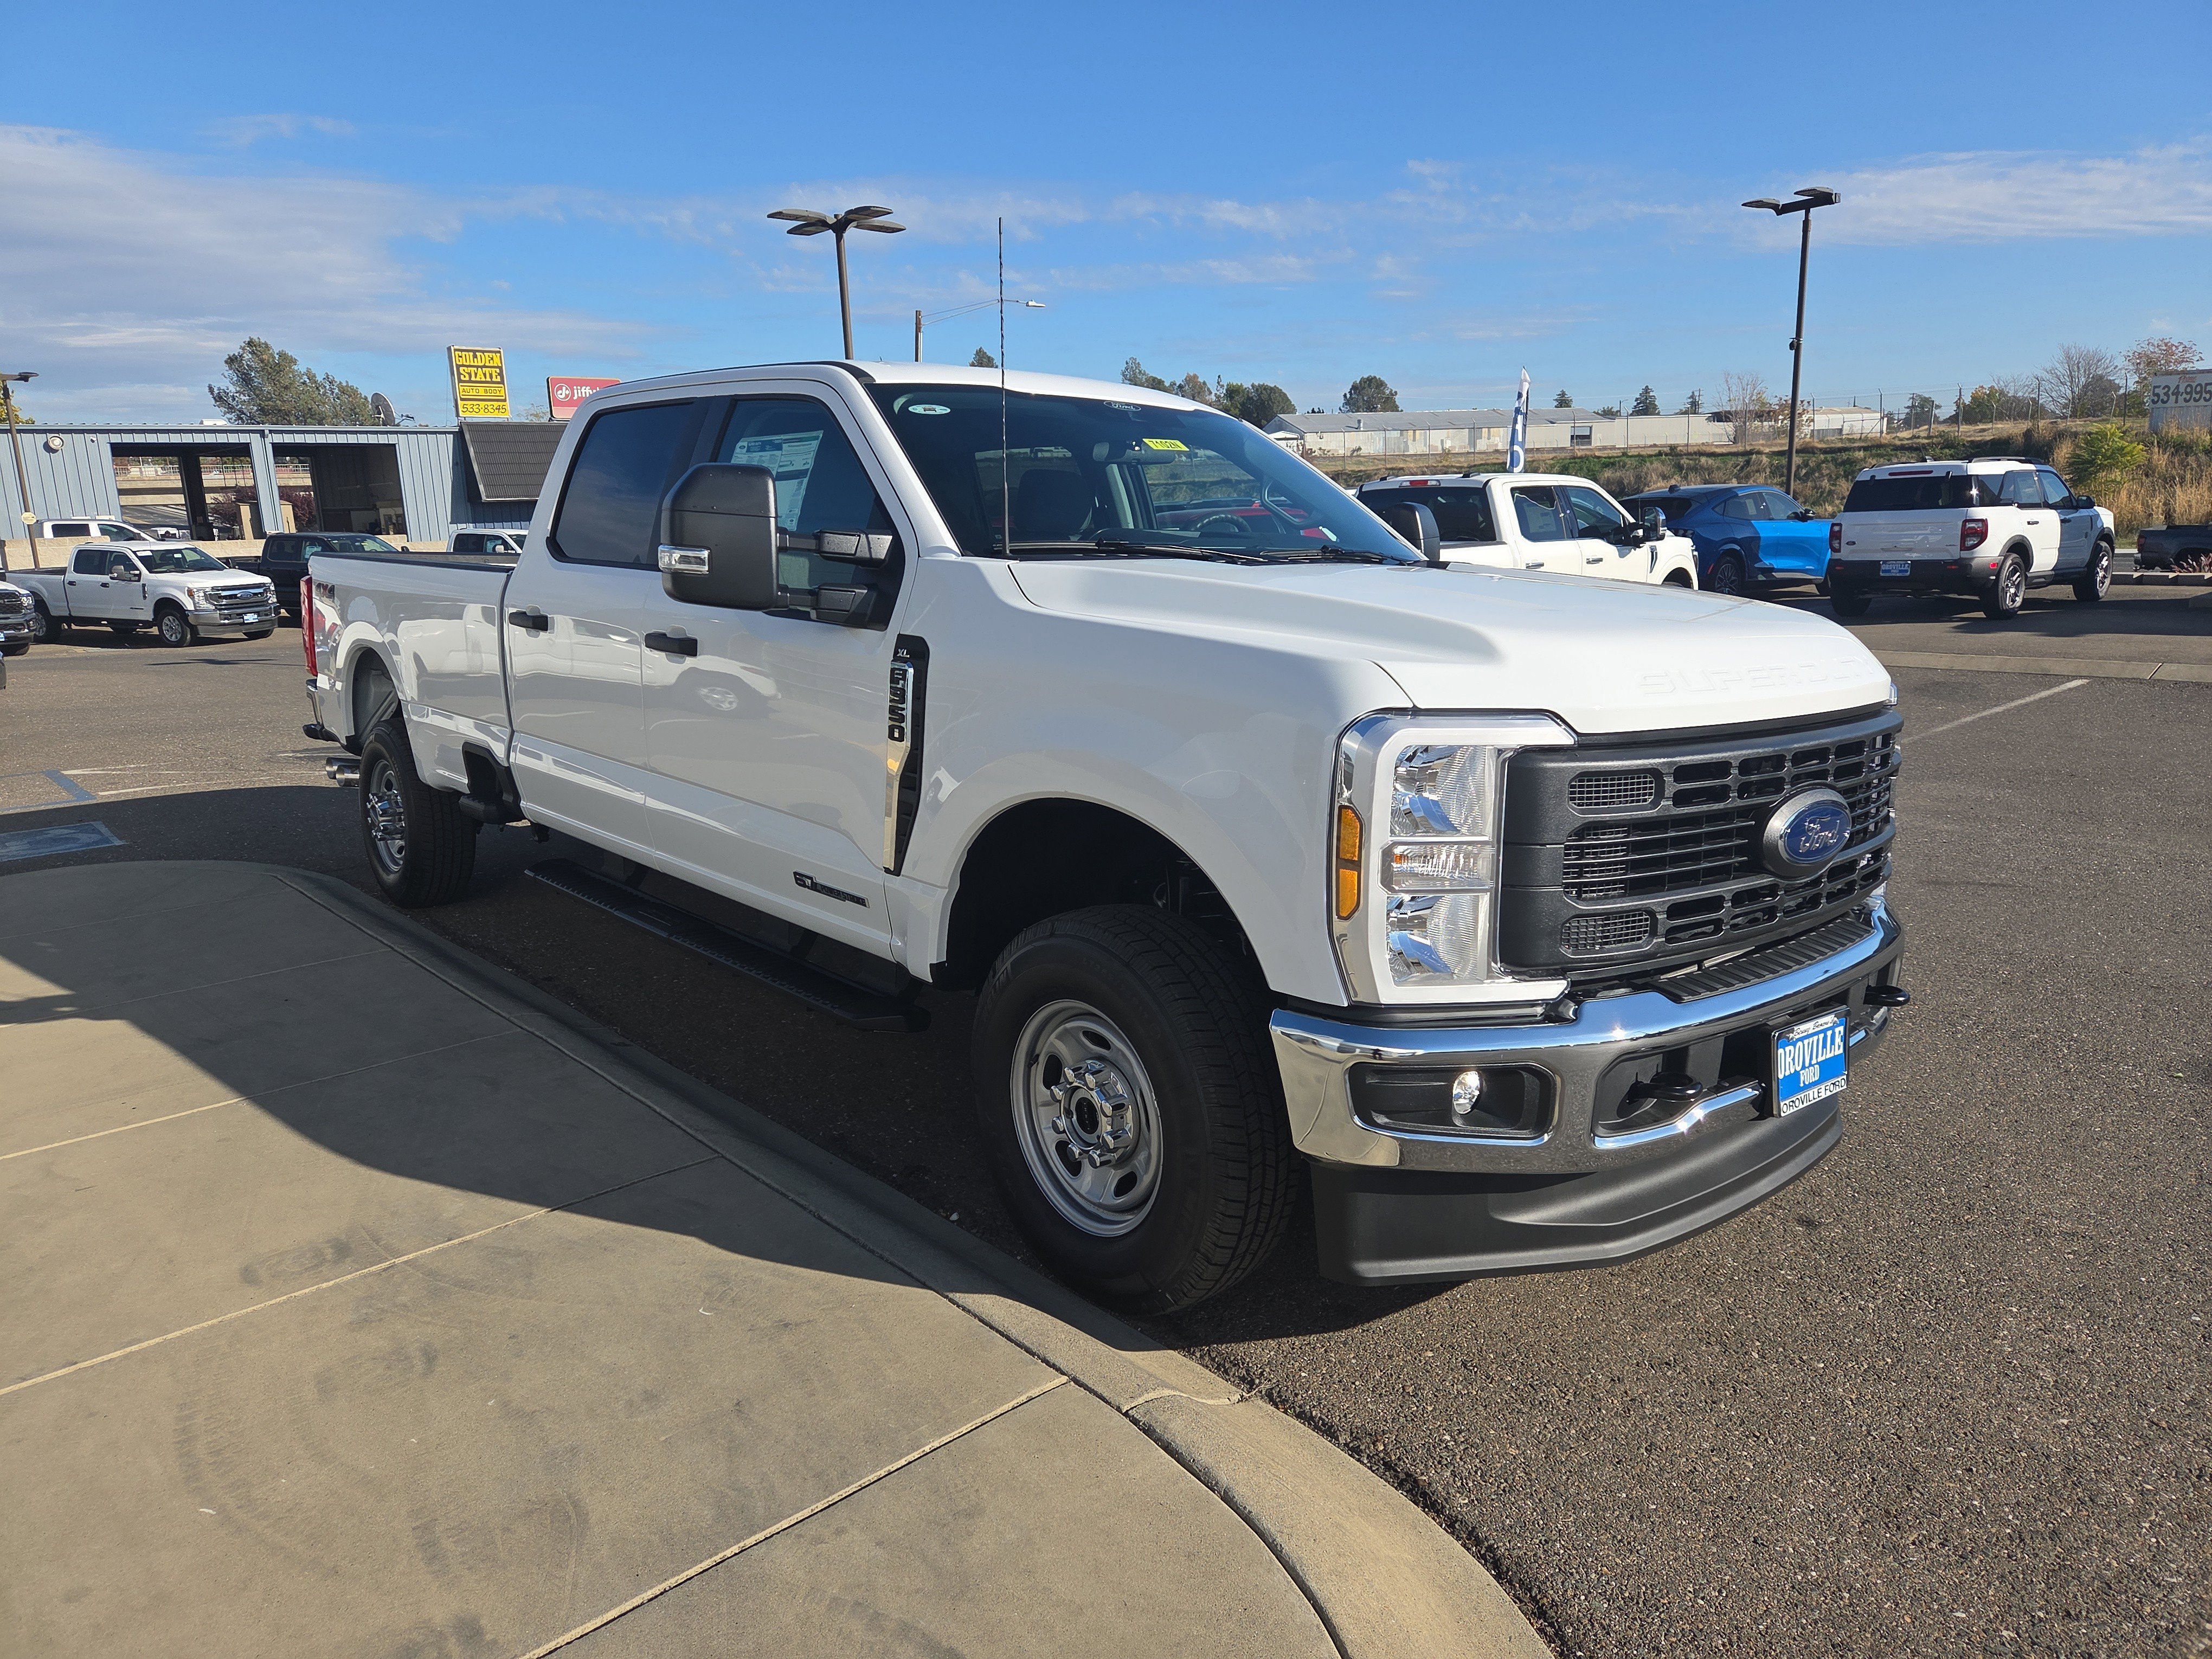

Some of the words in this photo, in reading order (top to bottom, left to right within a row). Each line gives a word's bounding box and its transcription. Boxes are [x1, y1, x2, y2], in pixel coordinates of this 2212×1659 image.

[455, 351, 501, 366] GOLDEN
[460, 367, 500, 381] STATE
[897, 648, 910, 658] XL
[1798, 814, 1841, 853] Ford
[1778, 1026, 1843, 1079] OROVILLE
[1799, 1064, 1819, 1087] FORD
[1782, 1087, 1822, 1114] OROVILLE
[1824, 1077, 1846, 1096] FORD
